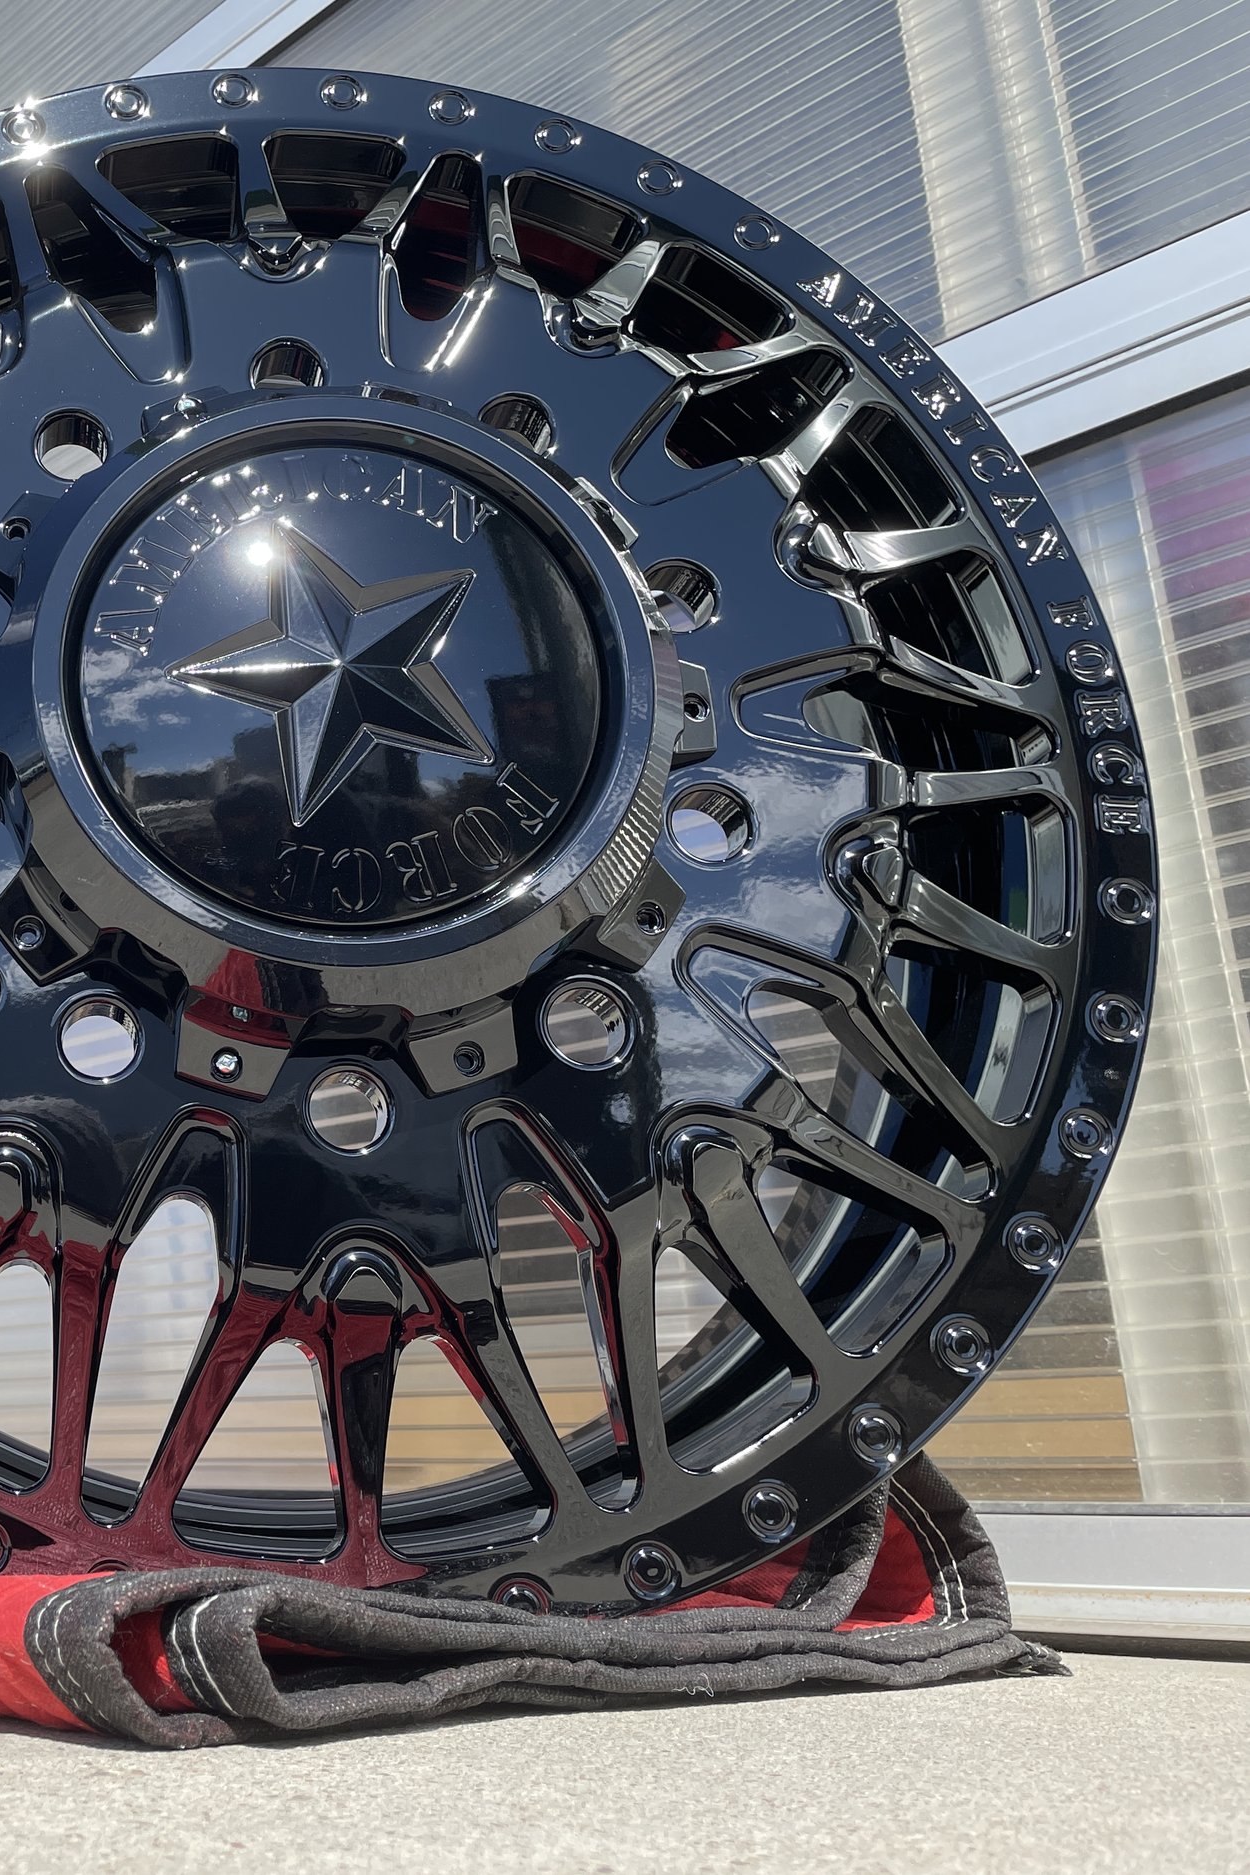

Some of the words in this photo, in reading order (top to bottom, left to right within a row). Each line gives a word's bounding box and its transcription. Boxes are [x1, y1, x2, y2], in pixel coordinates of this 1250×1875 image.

[94, 452, 500, 657] AMERICAN
[796, 271, 1069, 567] AMERICAN
[1047, 595, 1148, 836] FORCE
[270, 762, 560, 914] FORCE
